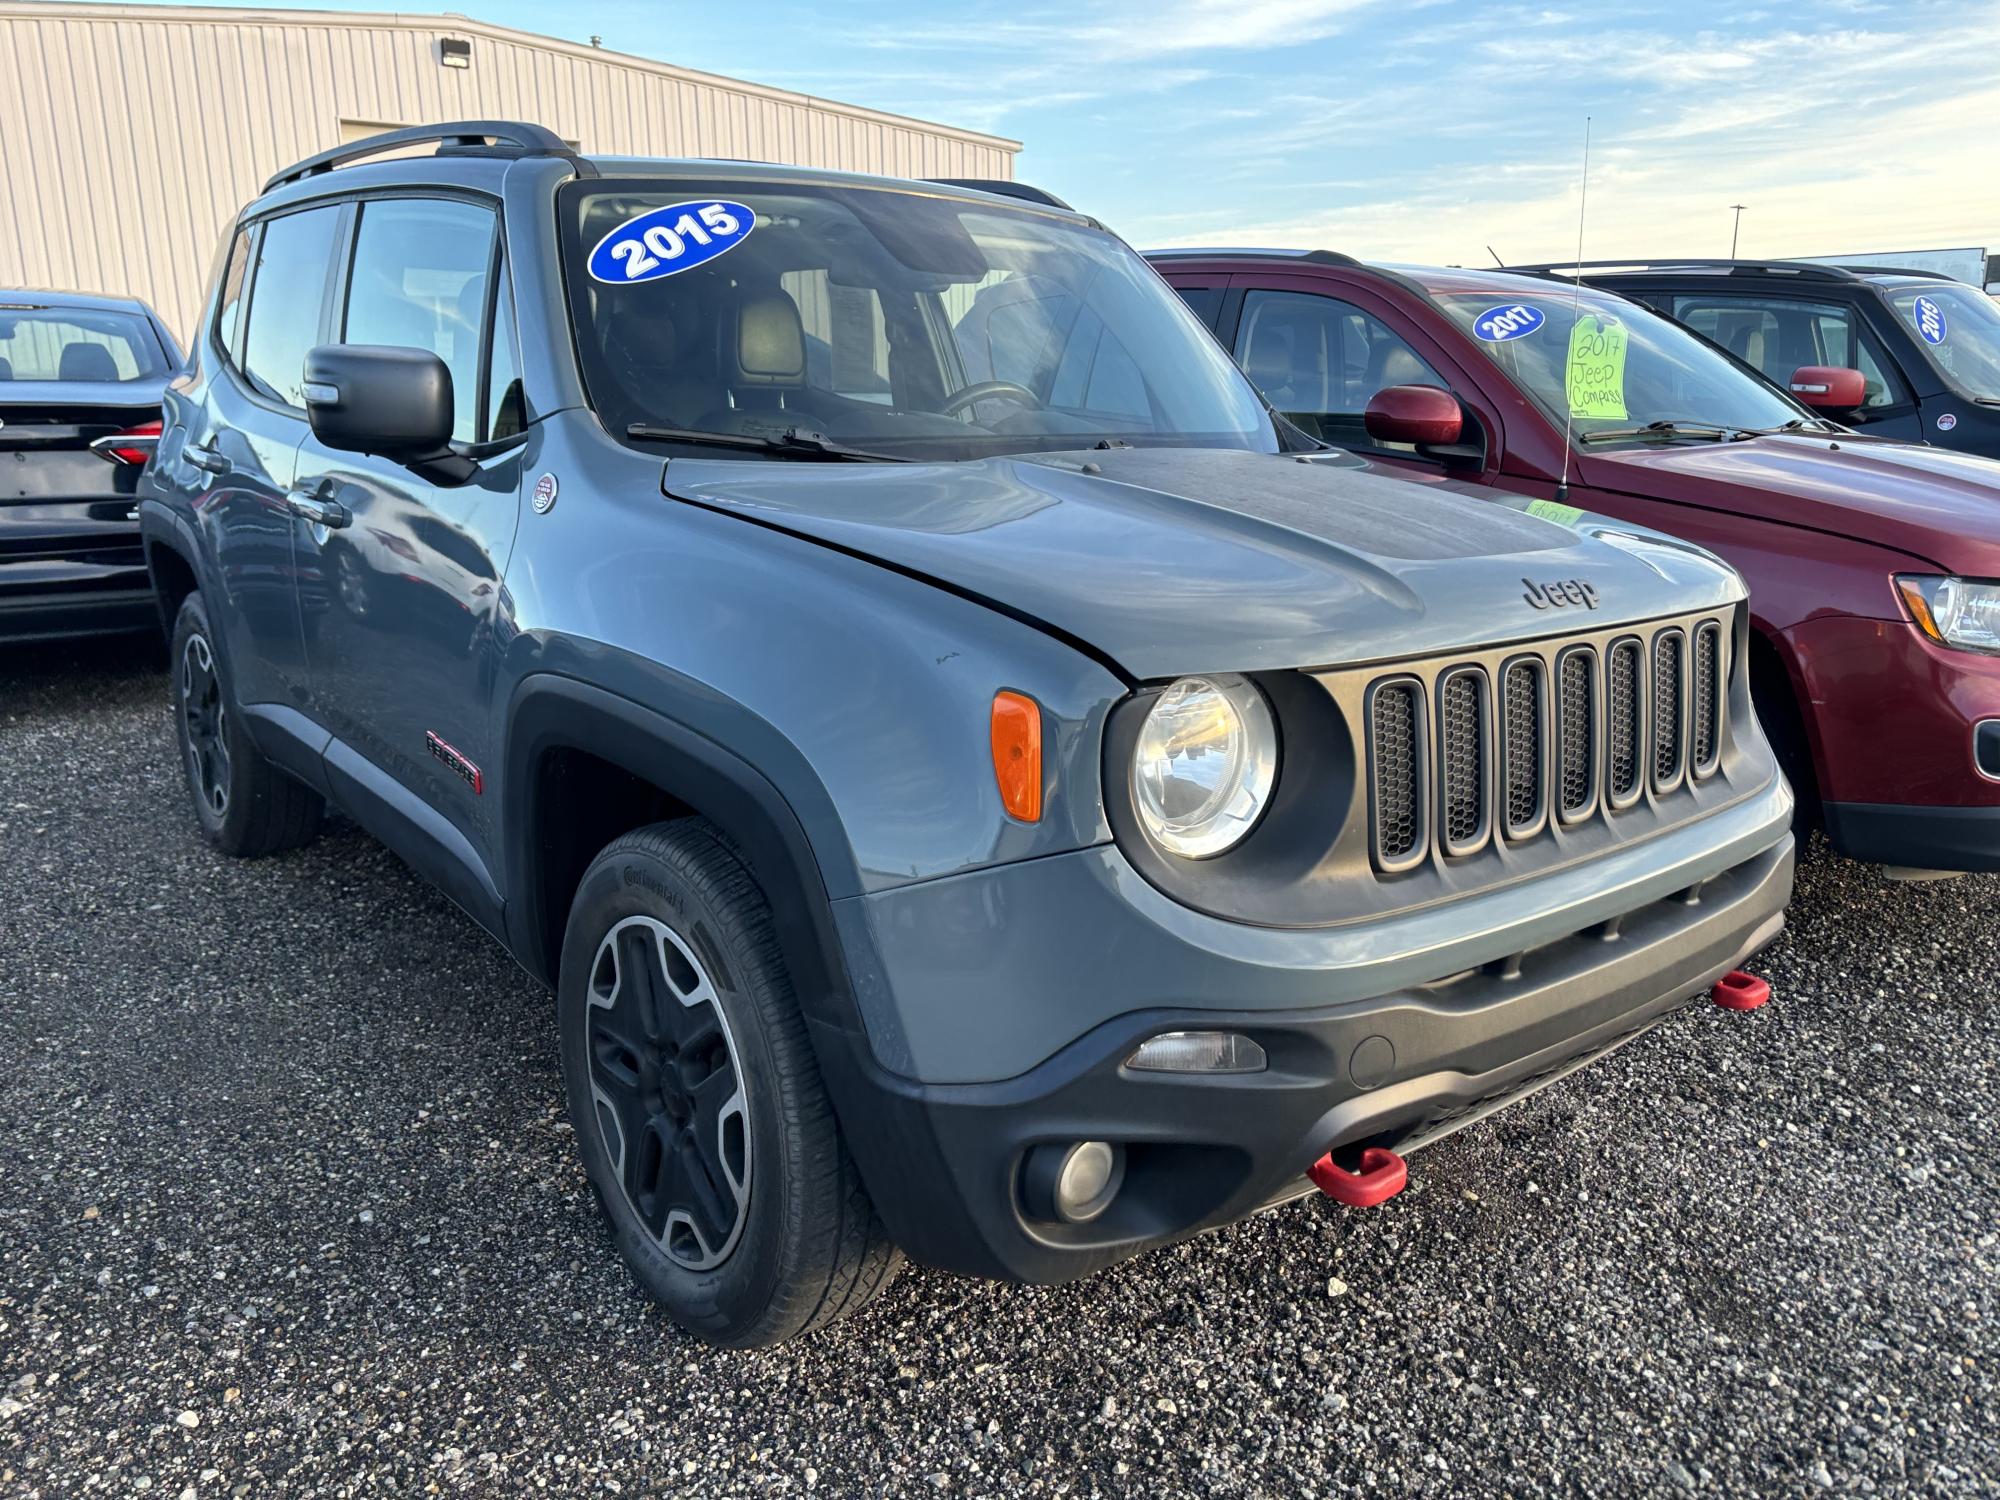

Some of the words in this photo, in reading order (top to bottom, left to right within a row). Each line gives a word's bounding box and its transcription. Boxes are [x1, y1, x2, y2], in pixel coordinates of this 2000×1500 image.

[611, 204, 740, 279] 2015
[1481, 305, 1536, 340] 2017
[1920, 298, 1940, 342] 2015
[1576, 334, 1620, 359] 2017
[1572, 362, 1615, 388] Jeep
[1572, 385, 1622, 408] Compass
[1521, 577, 1599, 610] Jeep
